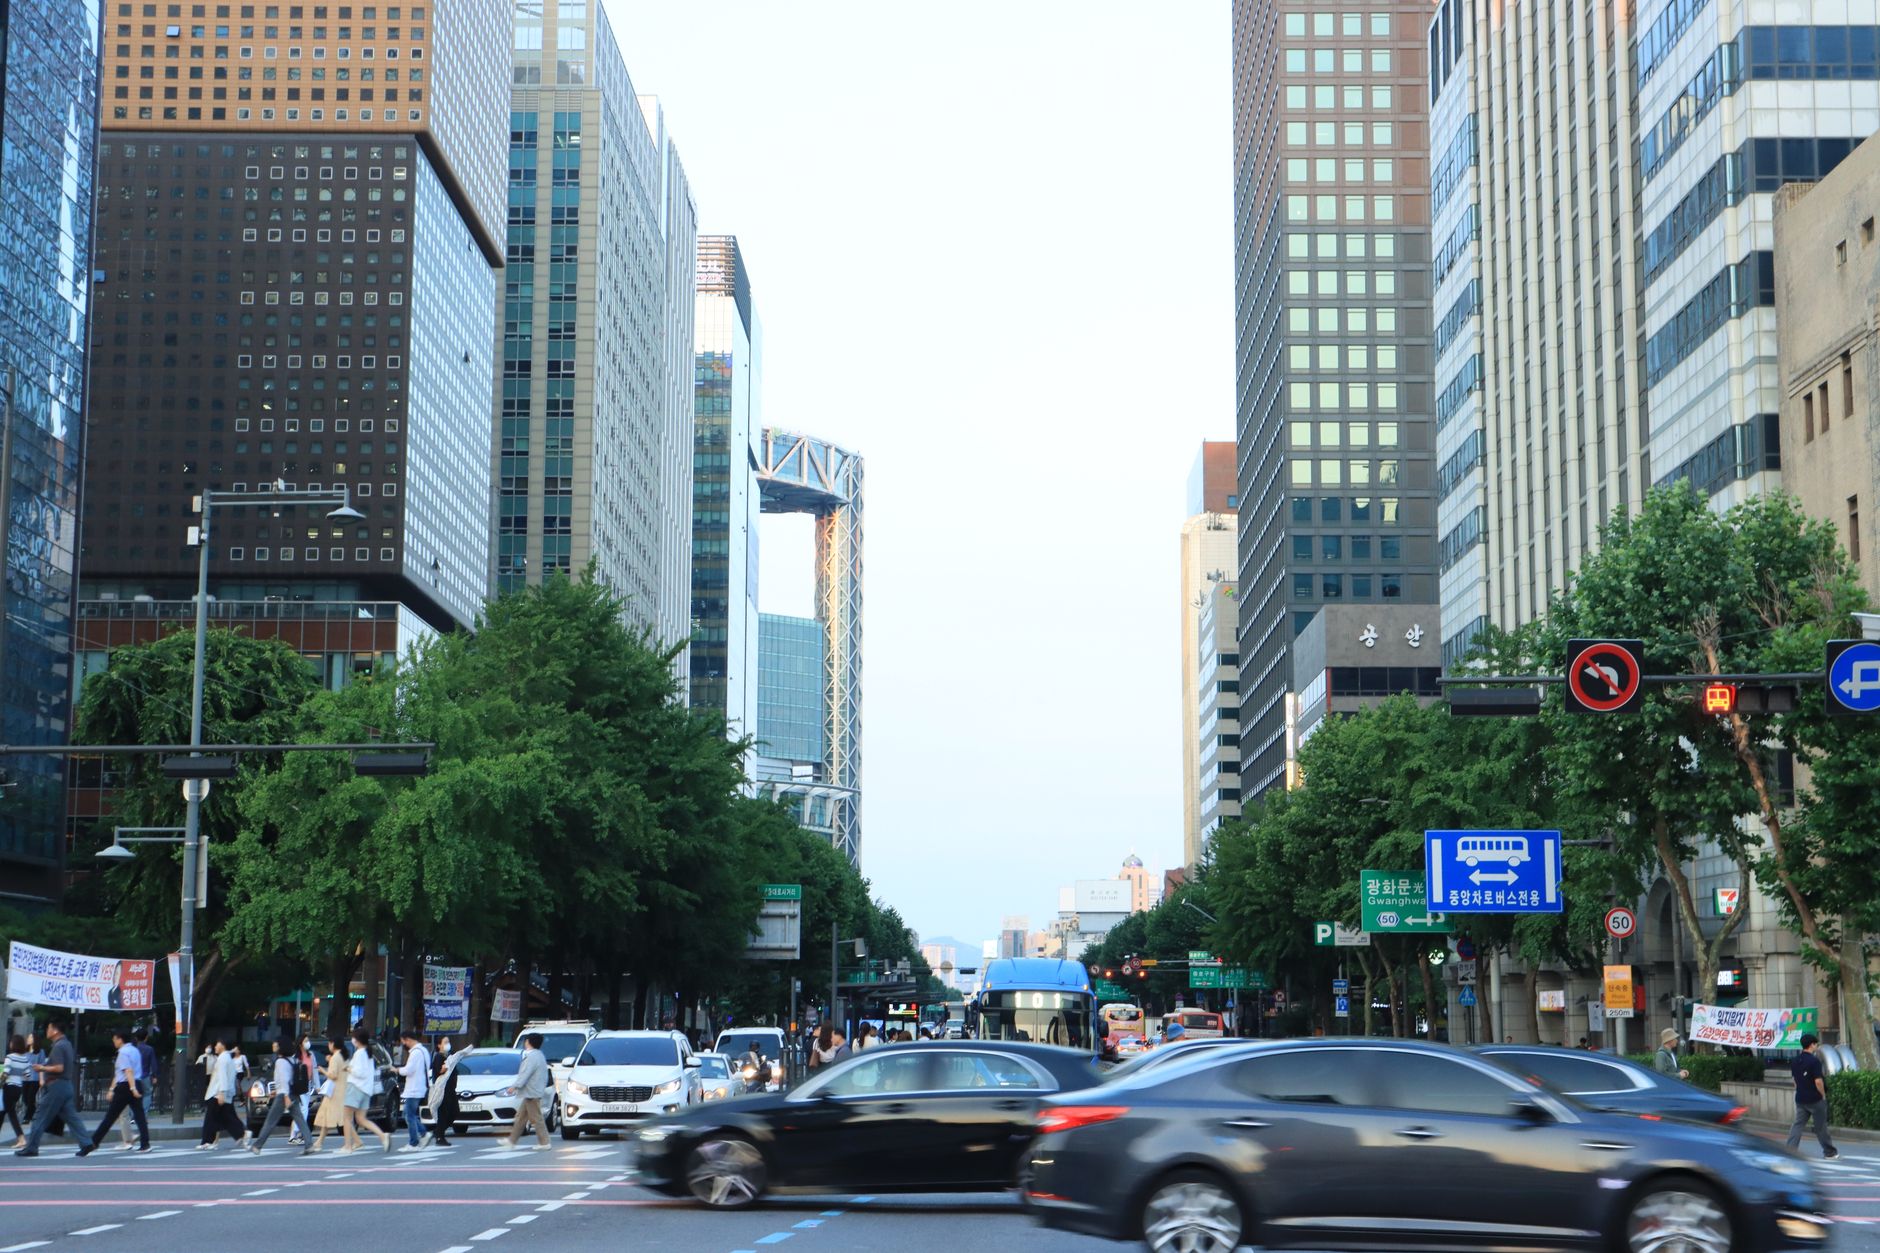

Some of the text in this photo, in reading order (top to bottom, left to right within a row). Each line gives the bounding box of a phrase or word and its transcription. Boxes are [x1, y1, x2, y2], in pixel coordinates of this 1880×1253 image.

[1366, 879, 1411, 896] 광화문
[1449, 889, 1540, 907] 중앙차로버스전용
[1381, 914, 1396, 925] 50
[1612, 916, 1630, 929] 50
[1316, 923, 1333, 943] P
[101, 963, 115, 981] YES
[85, 986, 101, 1004] YES
[1015, 992, 1060, 1009] 101
[1609, 1009, 1630, 1017] 250m
[1716, 1009, 1746, 1027] 잊지말자
